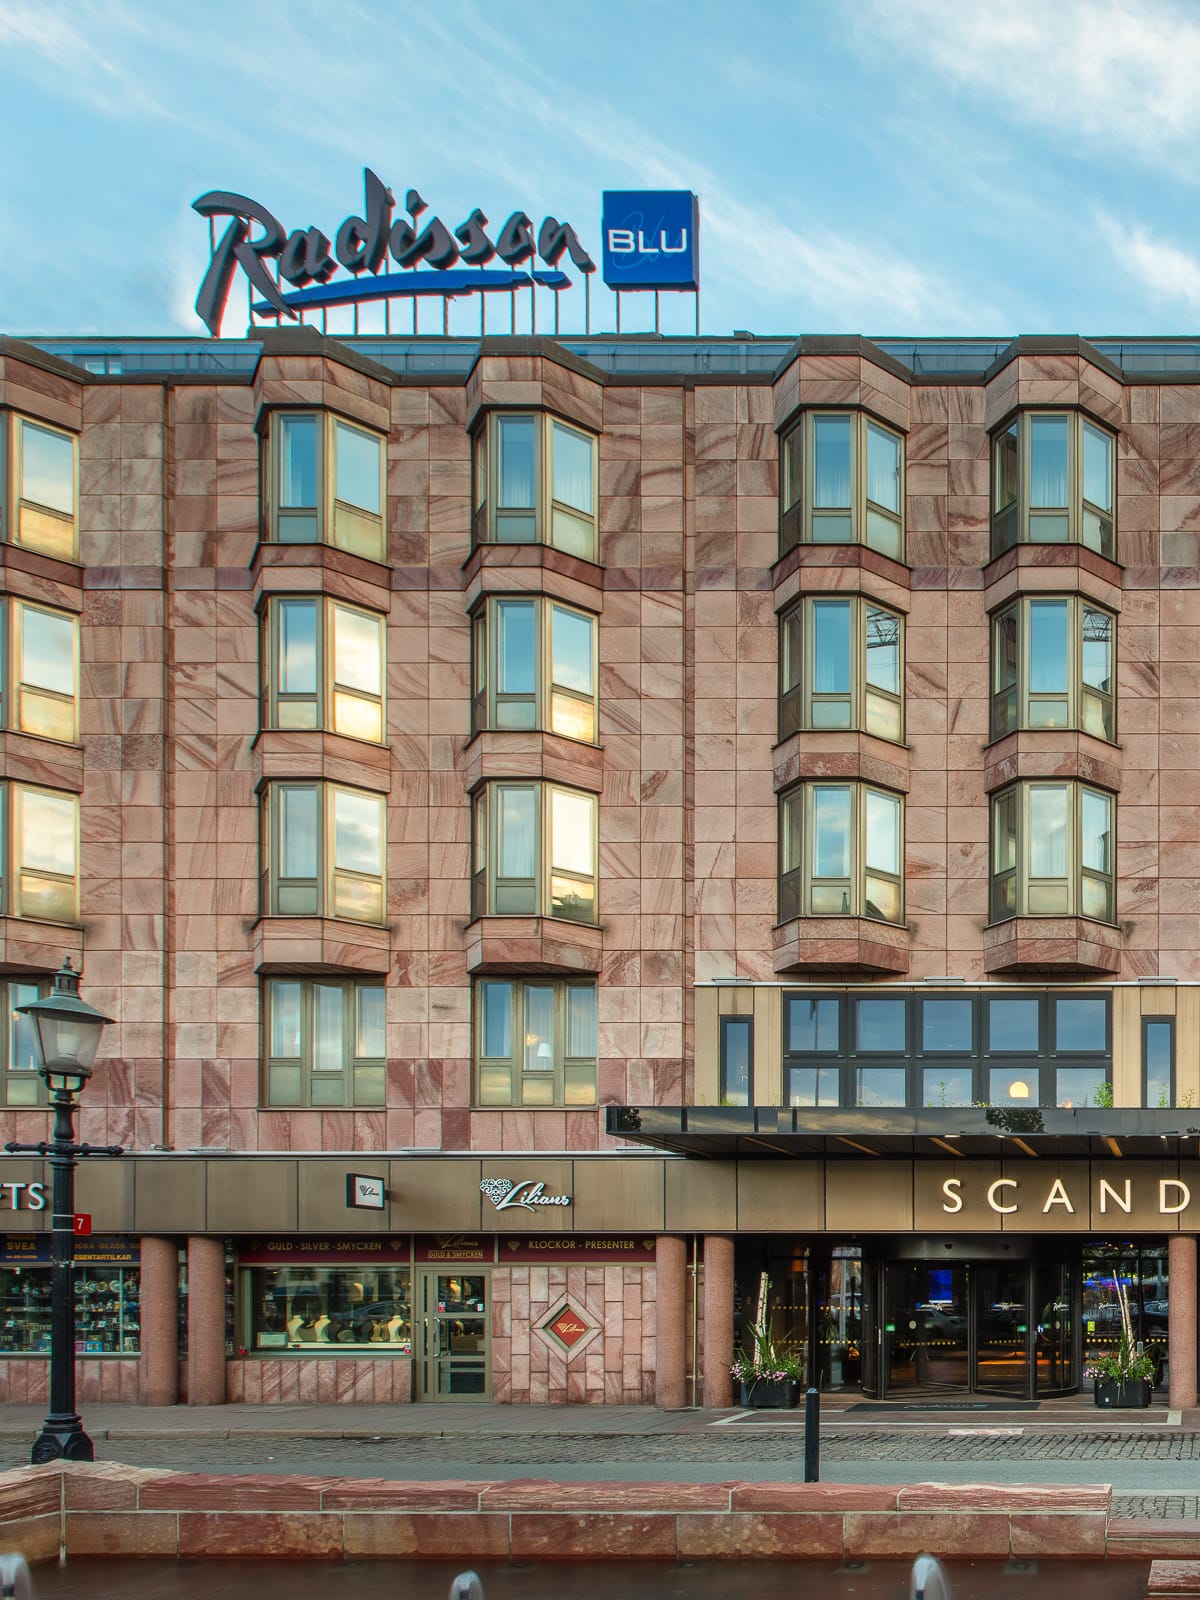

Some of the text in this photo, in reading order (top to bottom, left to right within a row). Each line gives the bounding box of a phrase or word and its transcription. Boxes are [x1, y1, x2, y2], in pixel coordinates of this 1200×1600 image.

[192, 167, 687, 337] Radisson BLU
[0, 1183, 45, 1210] TS
[496, 1180, 572, 1212] Lilians
[77, 1218, 84, 1230] 7
[7, 1242, 36, 1251] SVEA
[268, 1242, 382, 1251] GULD SILVER SMYCKEN
[528, 1240, 635, 1249] KLOCKOR PRESENTER
